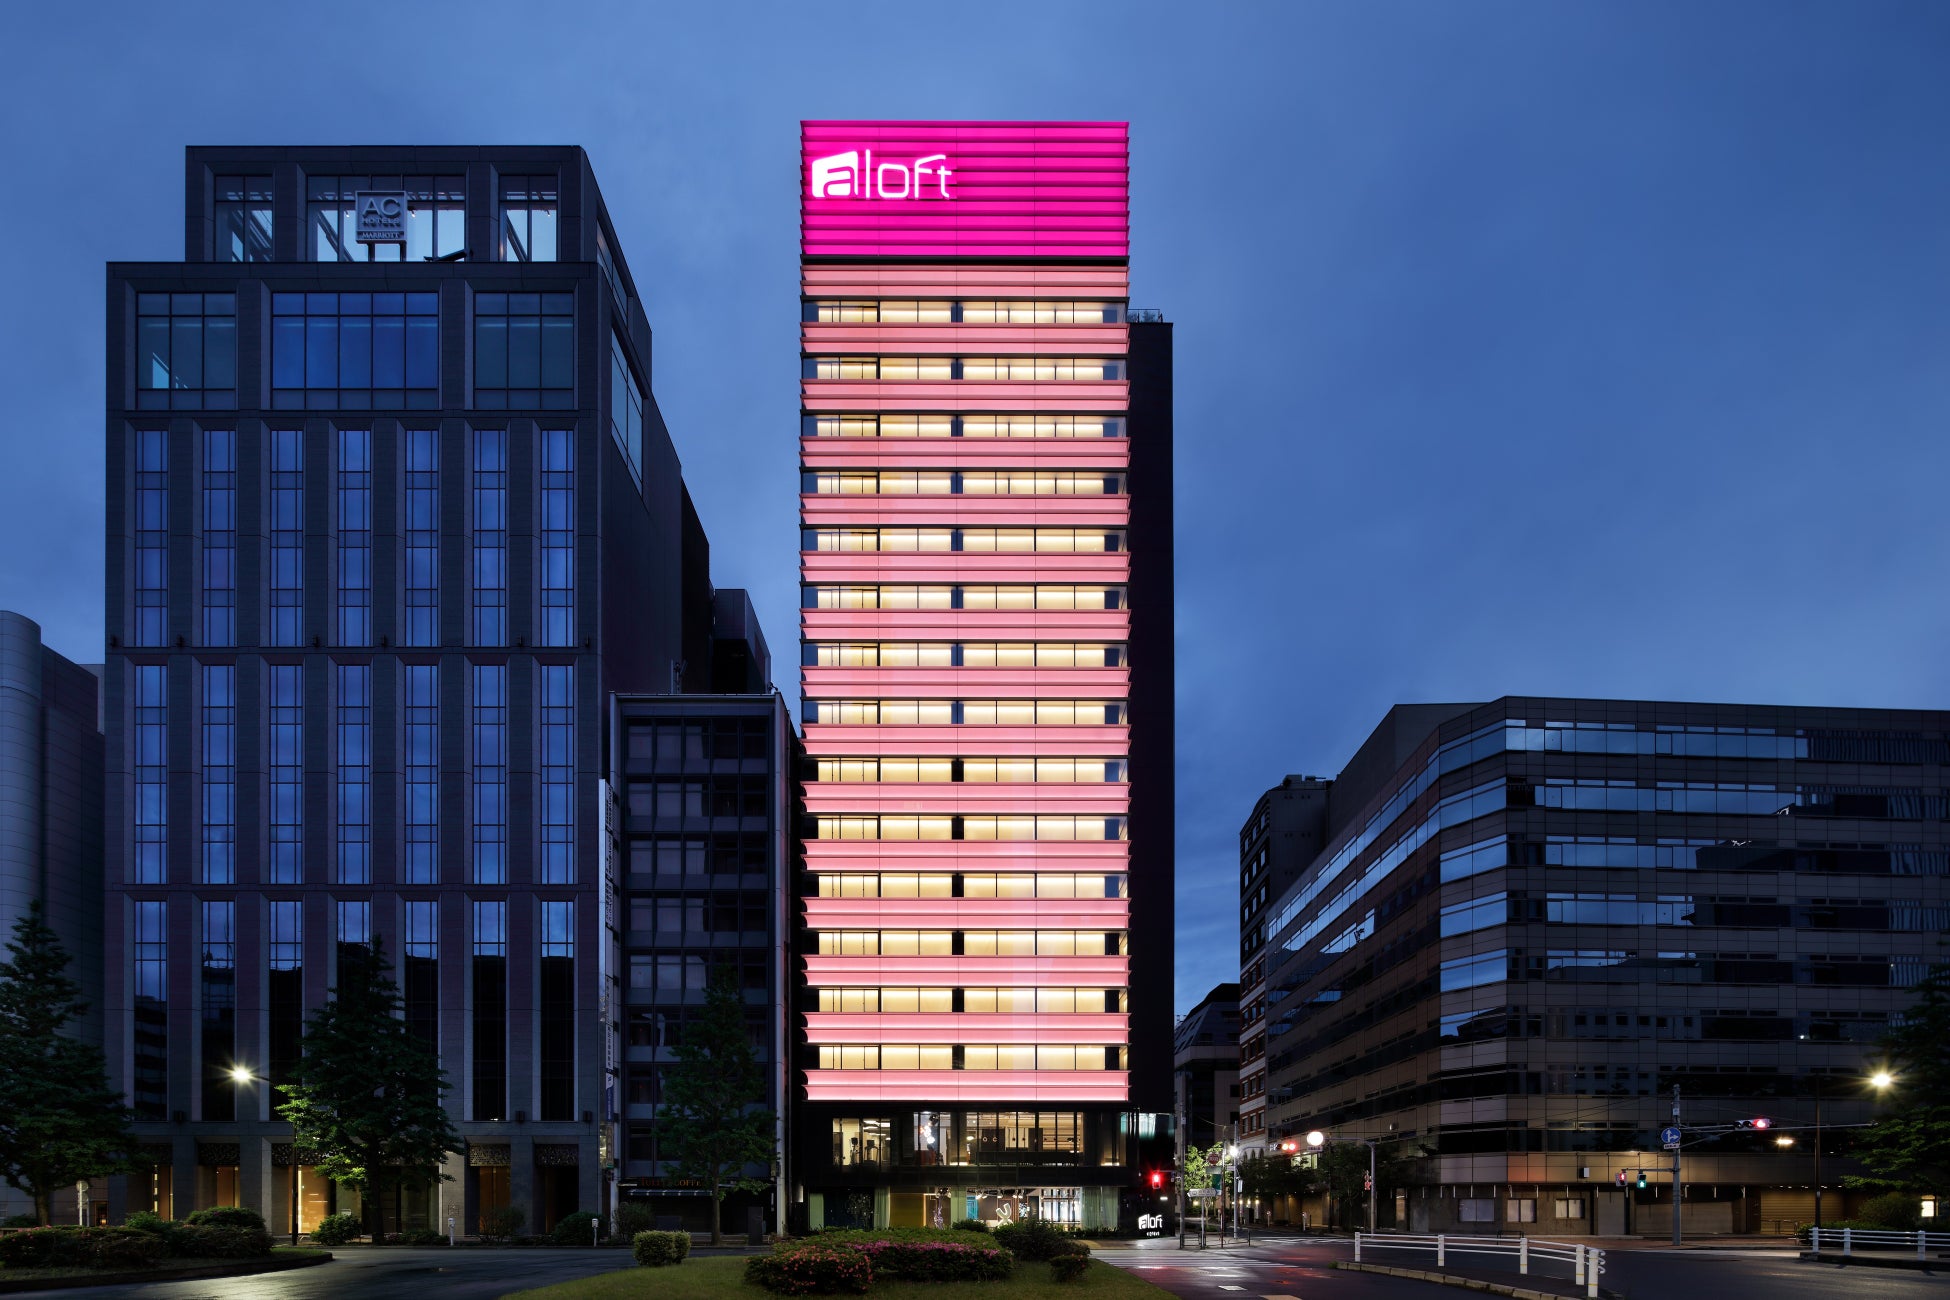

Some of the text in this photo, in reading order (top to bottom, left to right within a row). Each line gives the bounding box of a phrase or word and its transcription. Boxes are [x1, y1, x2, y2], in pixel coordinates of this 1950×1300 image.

[811, 149, 953, 199] aloft
[362, 197, 401, 216] AC
[362, 217, 400, 225] HOTELS
[1138, 1213, 1163, 1229] aloft
